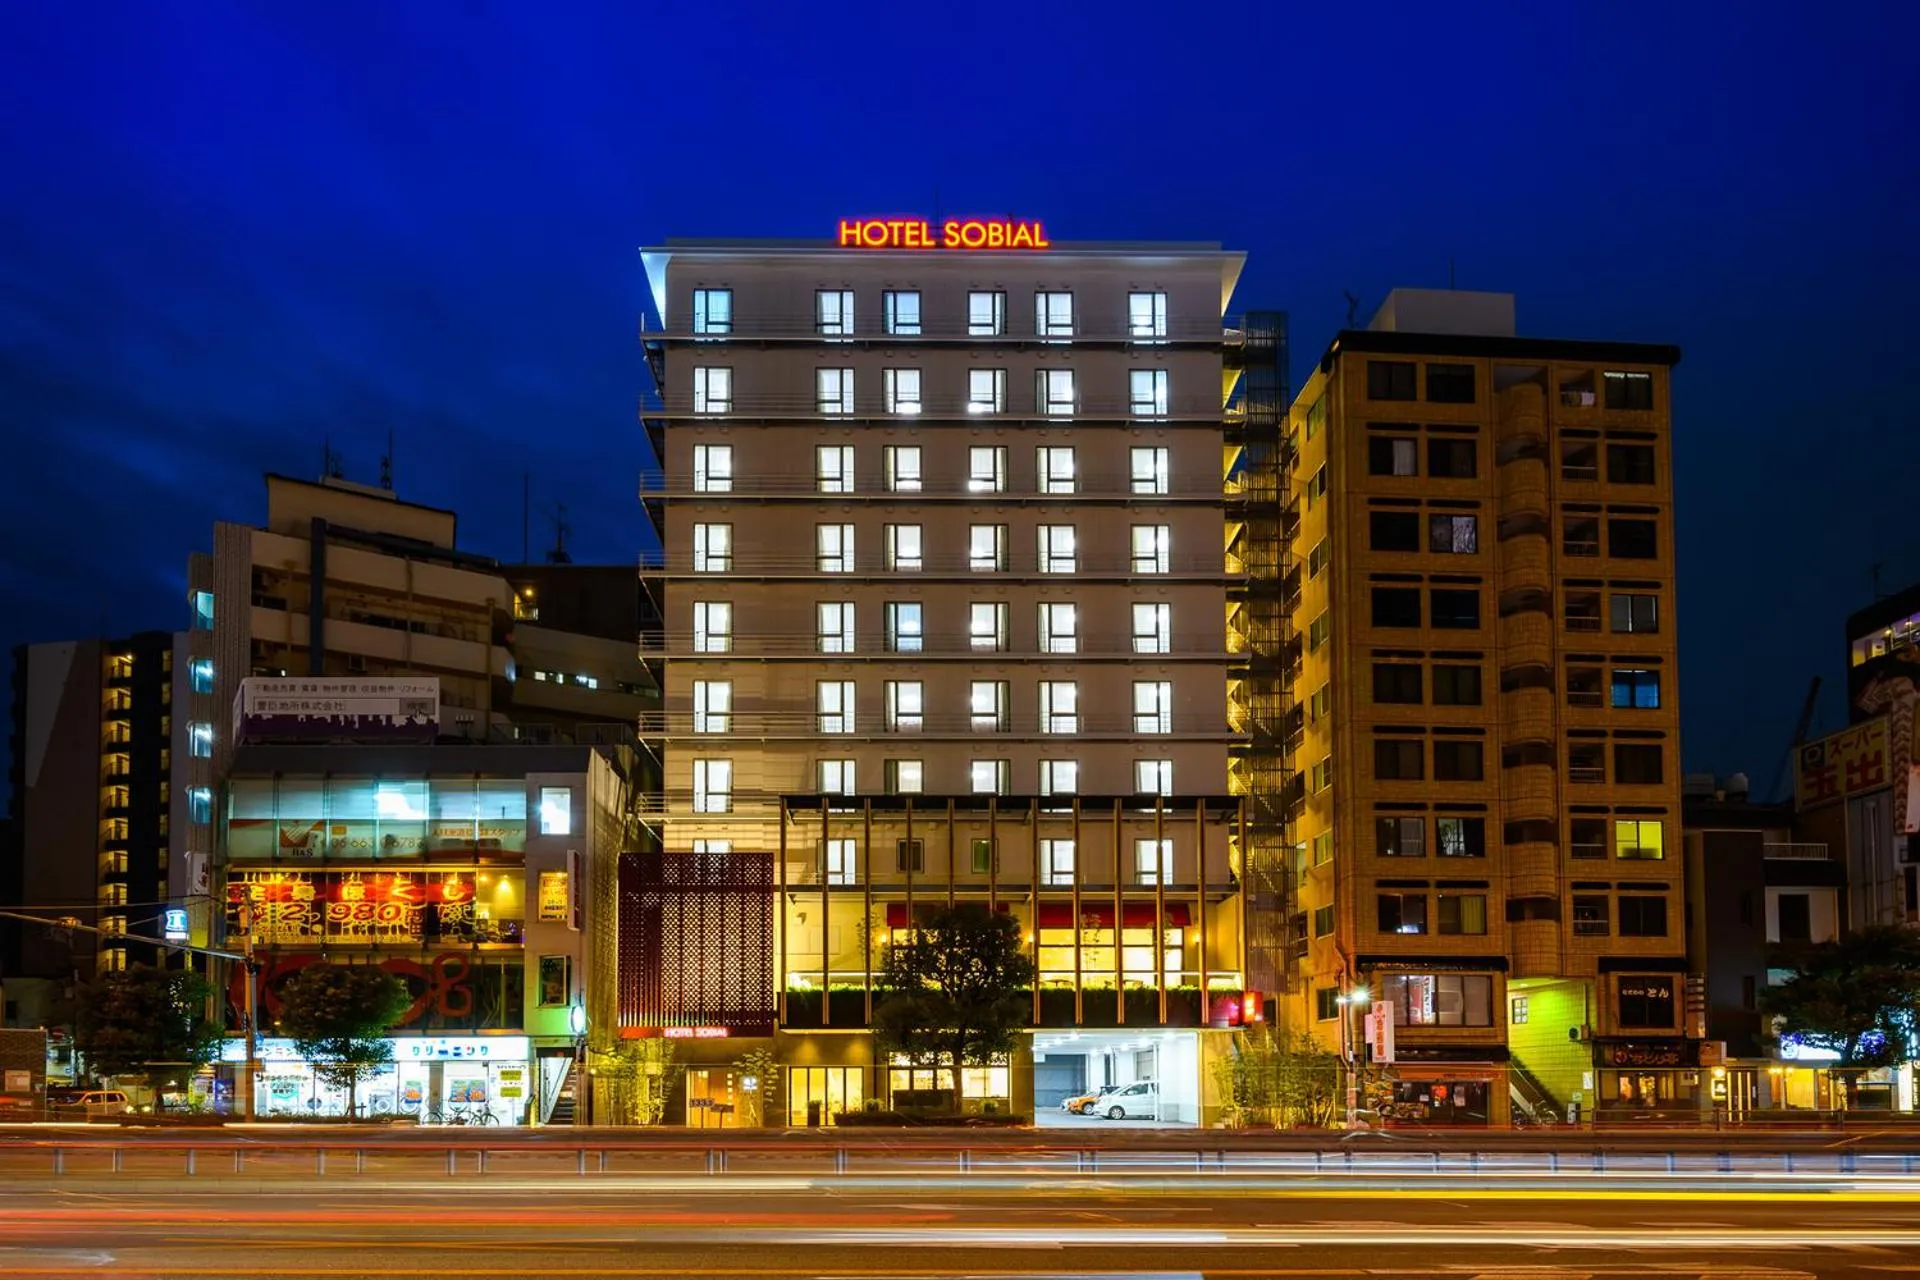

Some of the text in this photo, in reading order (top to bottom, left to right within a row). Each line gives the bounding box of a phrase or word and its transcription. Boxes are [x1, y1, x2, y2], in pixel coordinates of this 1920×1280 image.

[840, 220, 1049, 248] HOTEL SOBIAL
[1829, 725, 1884, 758] スーパー
[1802, 749, 1884, 805] 玉出
